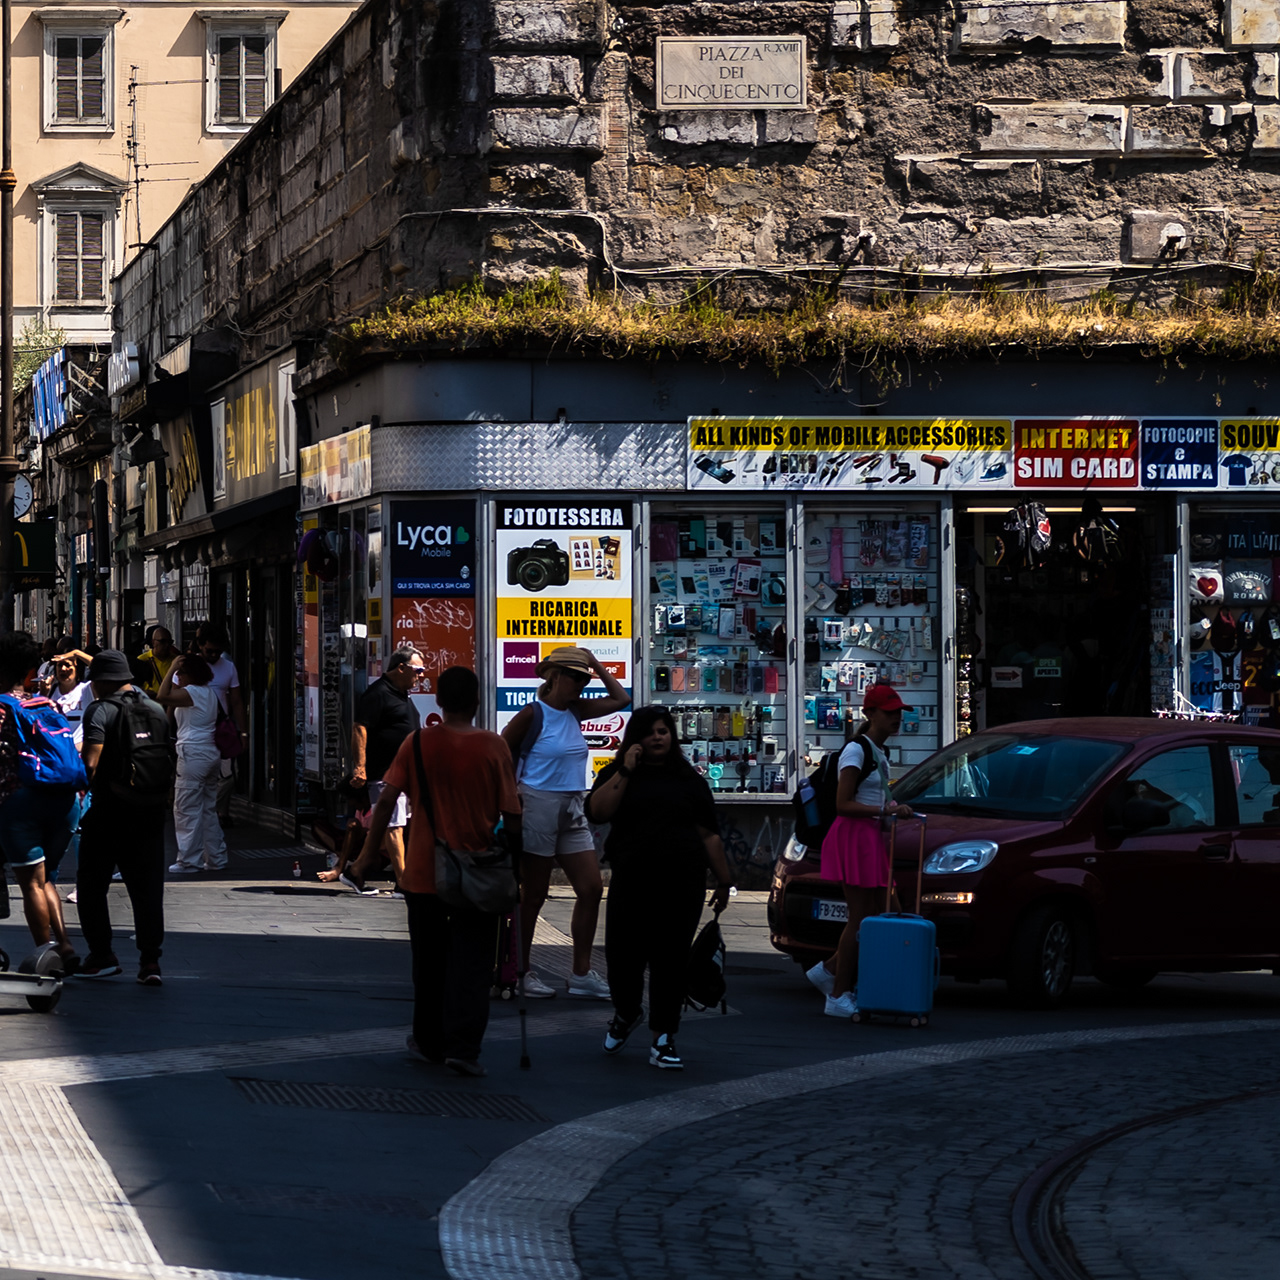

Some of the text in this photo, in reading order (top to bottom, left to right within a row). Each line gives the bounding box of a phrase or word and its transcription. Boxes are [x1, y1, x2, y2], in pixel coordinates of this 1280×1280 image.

[699, 46, 763, 62] PIAZZA
[719, 67, 743, 79] DEI
[664, 84, 799, 101] CINQUECENTO
[695, 425, 1005, 447] ALL KINDS OF MOBILE ACCESSORIES
[1022, 427, 1134, 450] INTERNET
[1144, 427, 1215, 444] FOTOCOPIE
[1223, 424, 1280, 448] SOUV
[1017, 456, 1135, 480] SIM CARD
[1146, 463, 1214, 480] STAMPA
[24, 491, 30, 501] 3
[504, 508, 624, 526] FOTOTESSERA
[397, 521, 452, 550] Lyca
[421, 547, 452, 557] Mobile
[530, 601, 598, 617] RICARICA
[396, 614, 414, 628] ria
[506, 619, 622, 636] INTERNAZIONALE
[592, 646, 619, 655] onatel
[505, 654, 537, 664] africell
[1214, 681, 1241, 691] Jeep
[505, 692, 538, 706] TICK
[581, 722, 612, 732] abus
